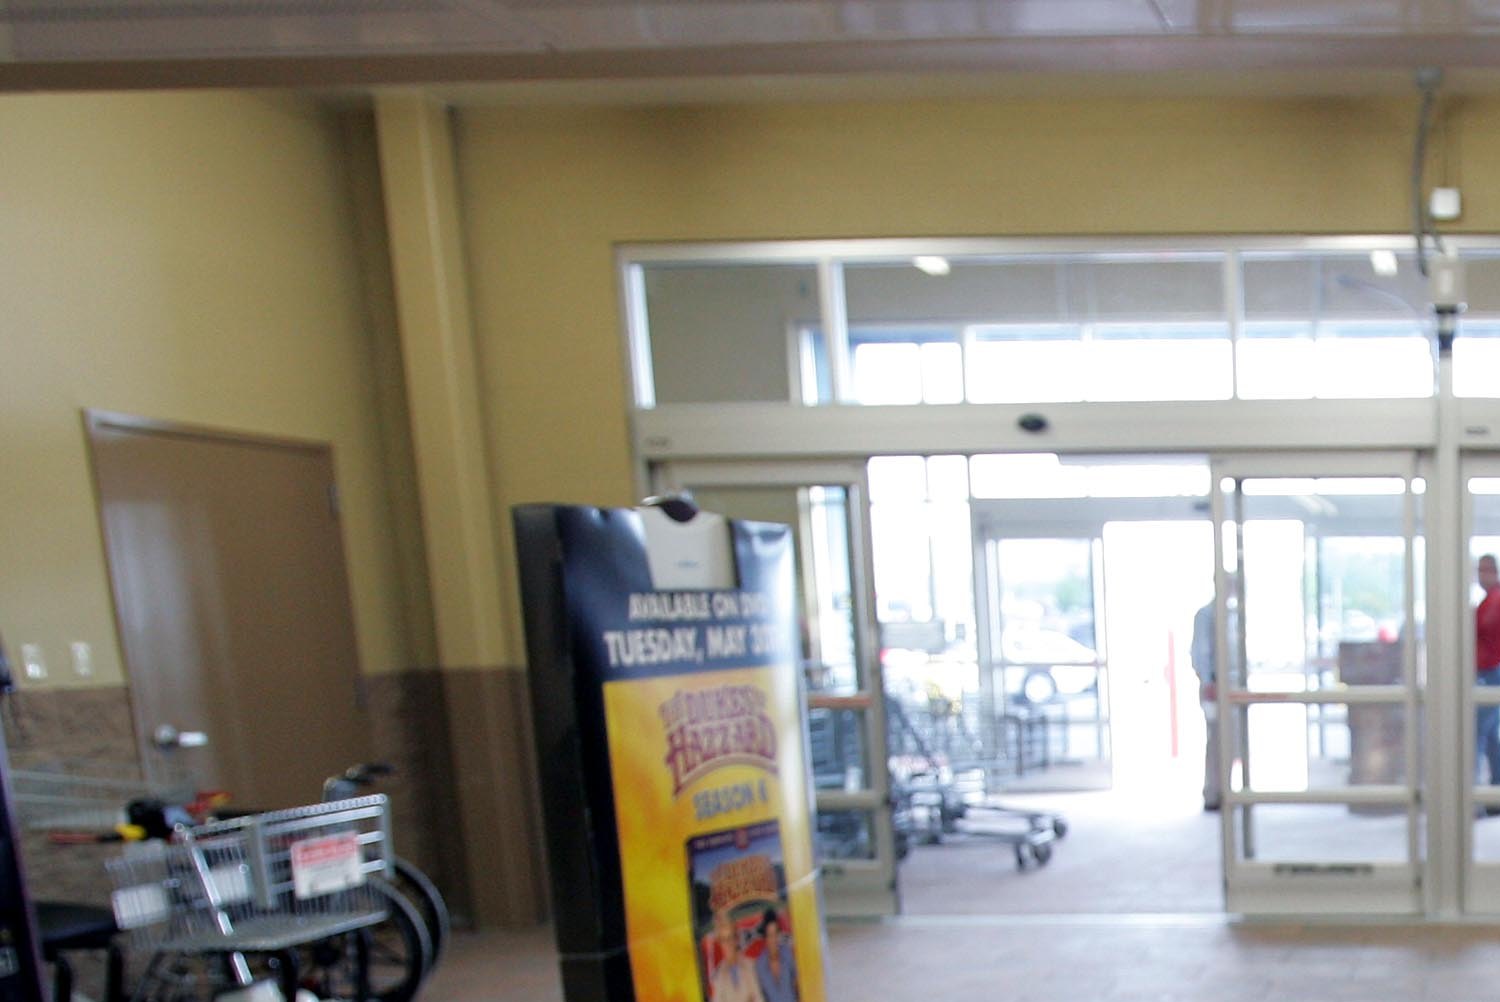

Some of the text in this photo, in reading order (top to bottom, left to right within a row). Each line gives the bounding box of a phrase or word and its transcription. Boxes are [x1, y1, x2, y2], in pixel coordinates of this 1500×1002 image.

[628, 592, 711, 622] AVAILABLE
[712, 592, 738, 619] ON
[604, 627, 704, 668] TUESDAY,
[706, 625, 747, 658] MAY
